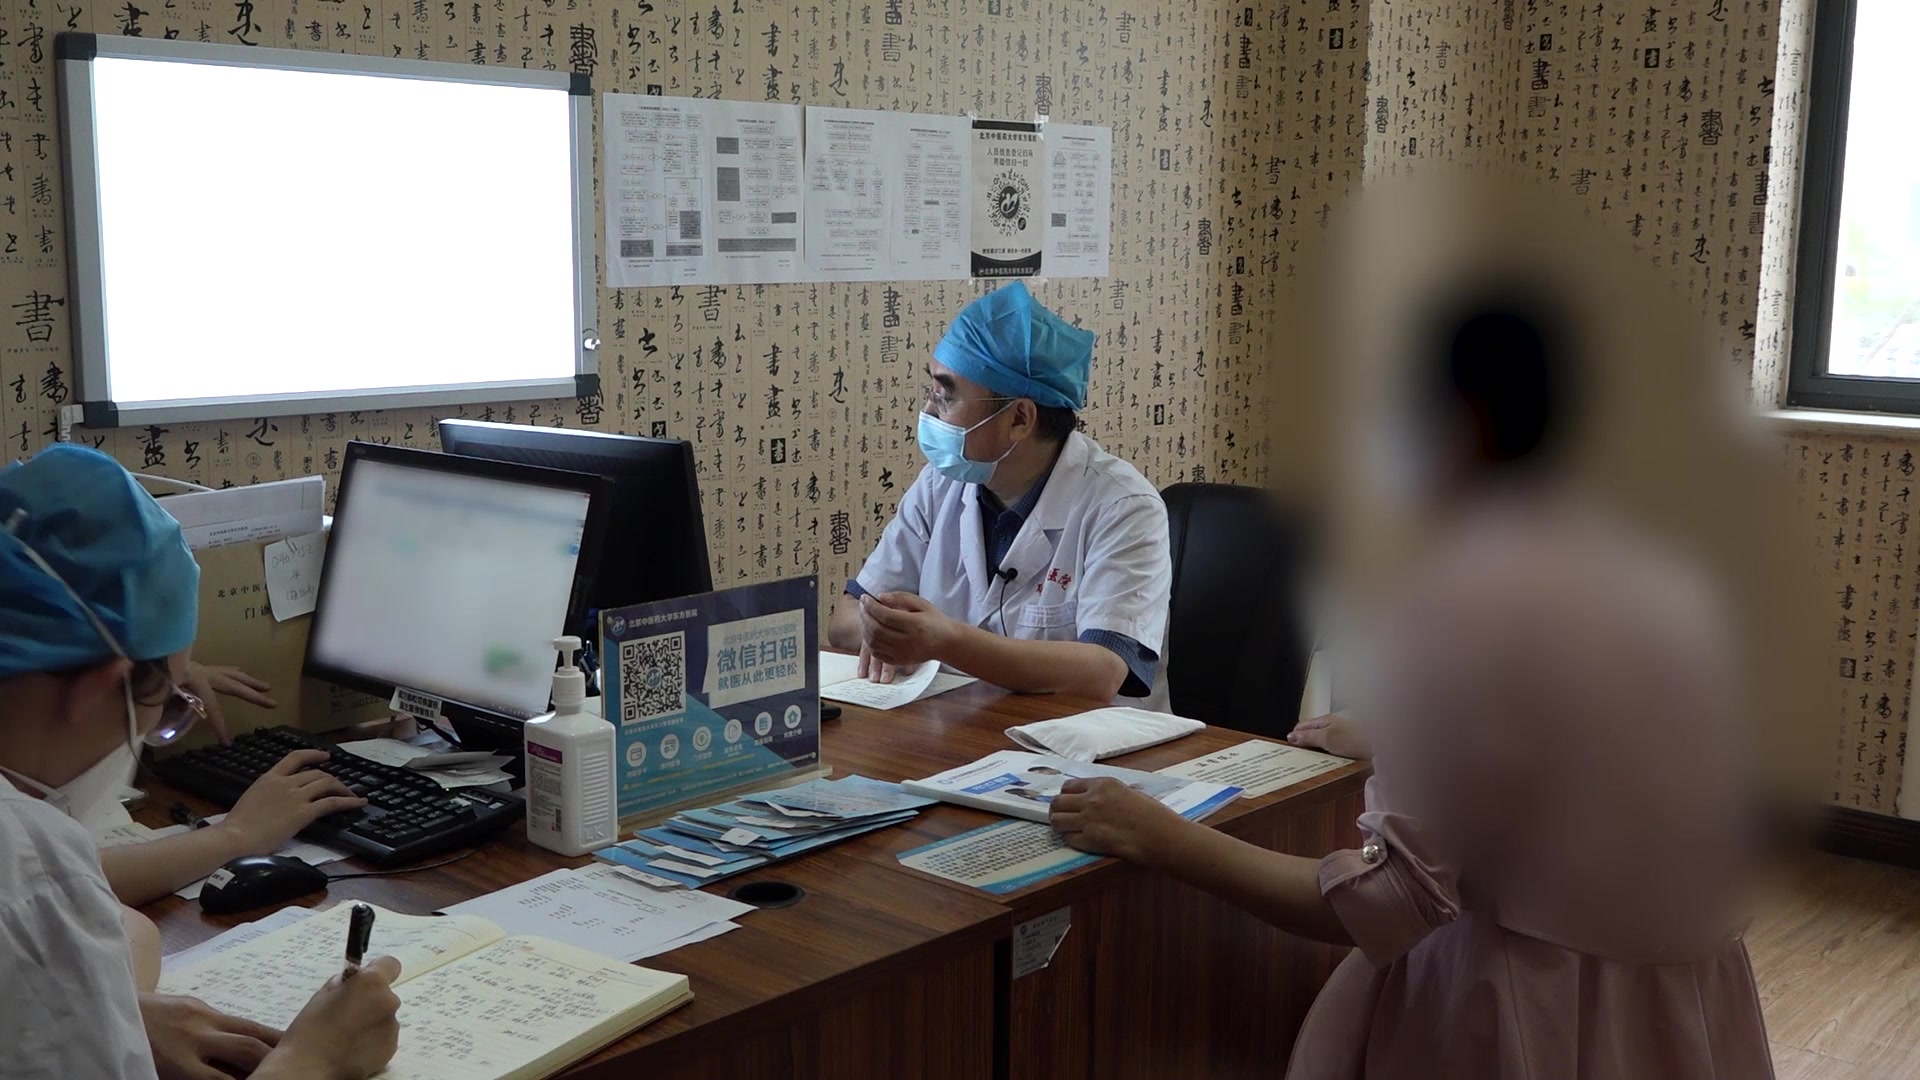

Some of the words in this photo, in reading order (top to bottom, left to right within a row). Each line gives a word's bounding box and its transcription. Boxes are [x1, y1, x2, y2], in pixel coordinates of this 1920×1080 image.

[629, 609, 698, 629] 北京中医药大学东方医院
[717, 636, 798, 674] 微信扫码
[717, 663, 798, 691] 就医从此更轻松
